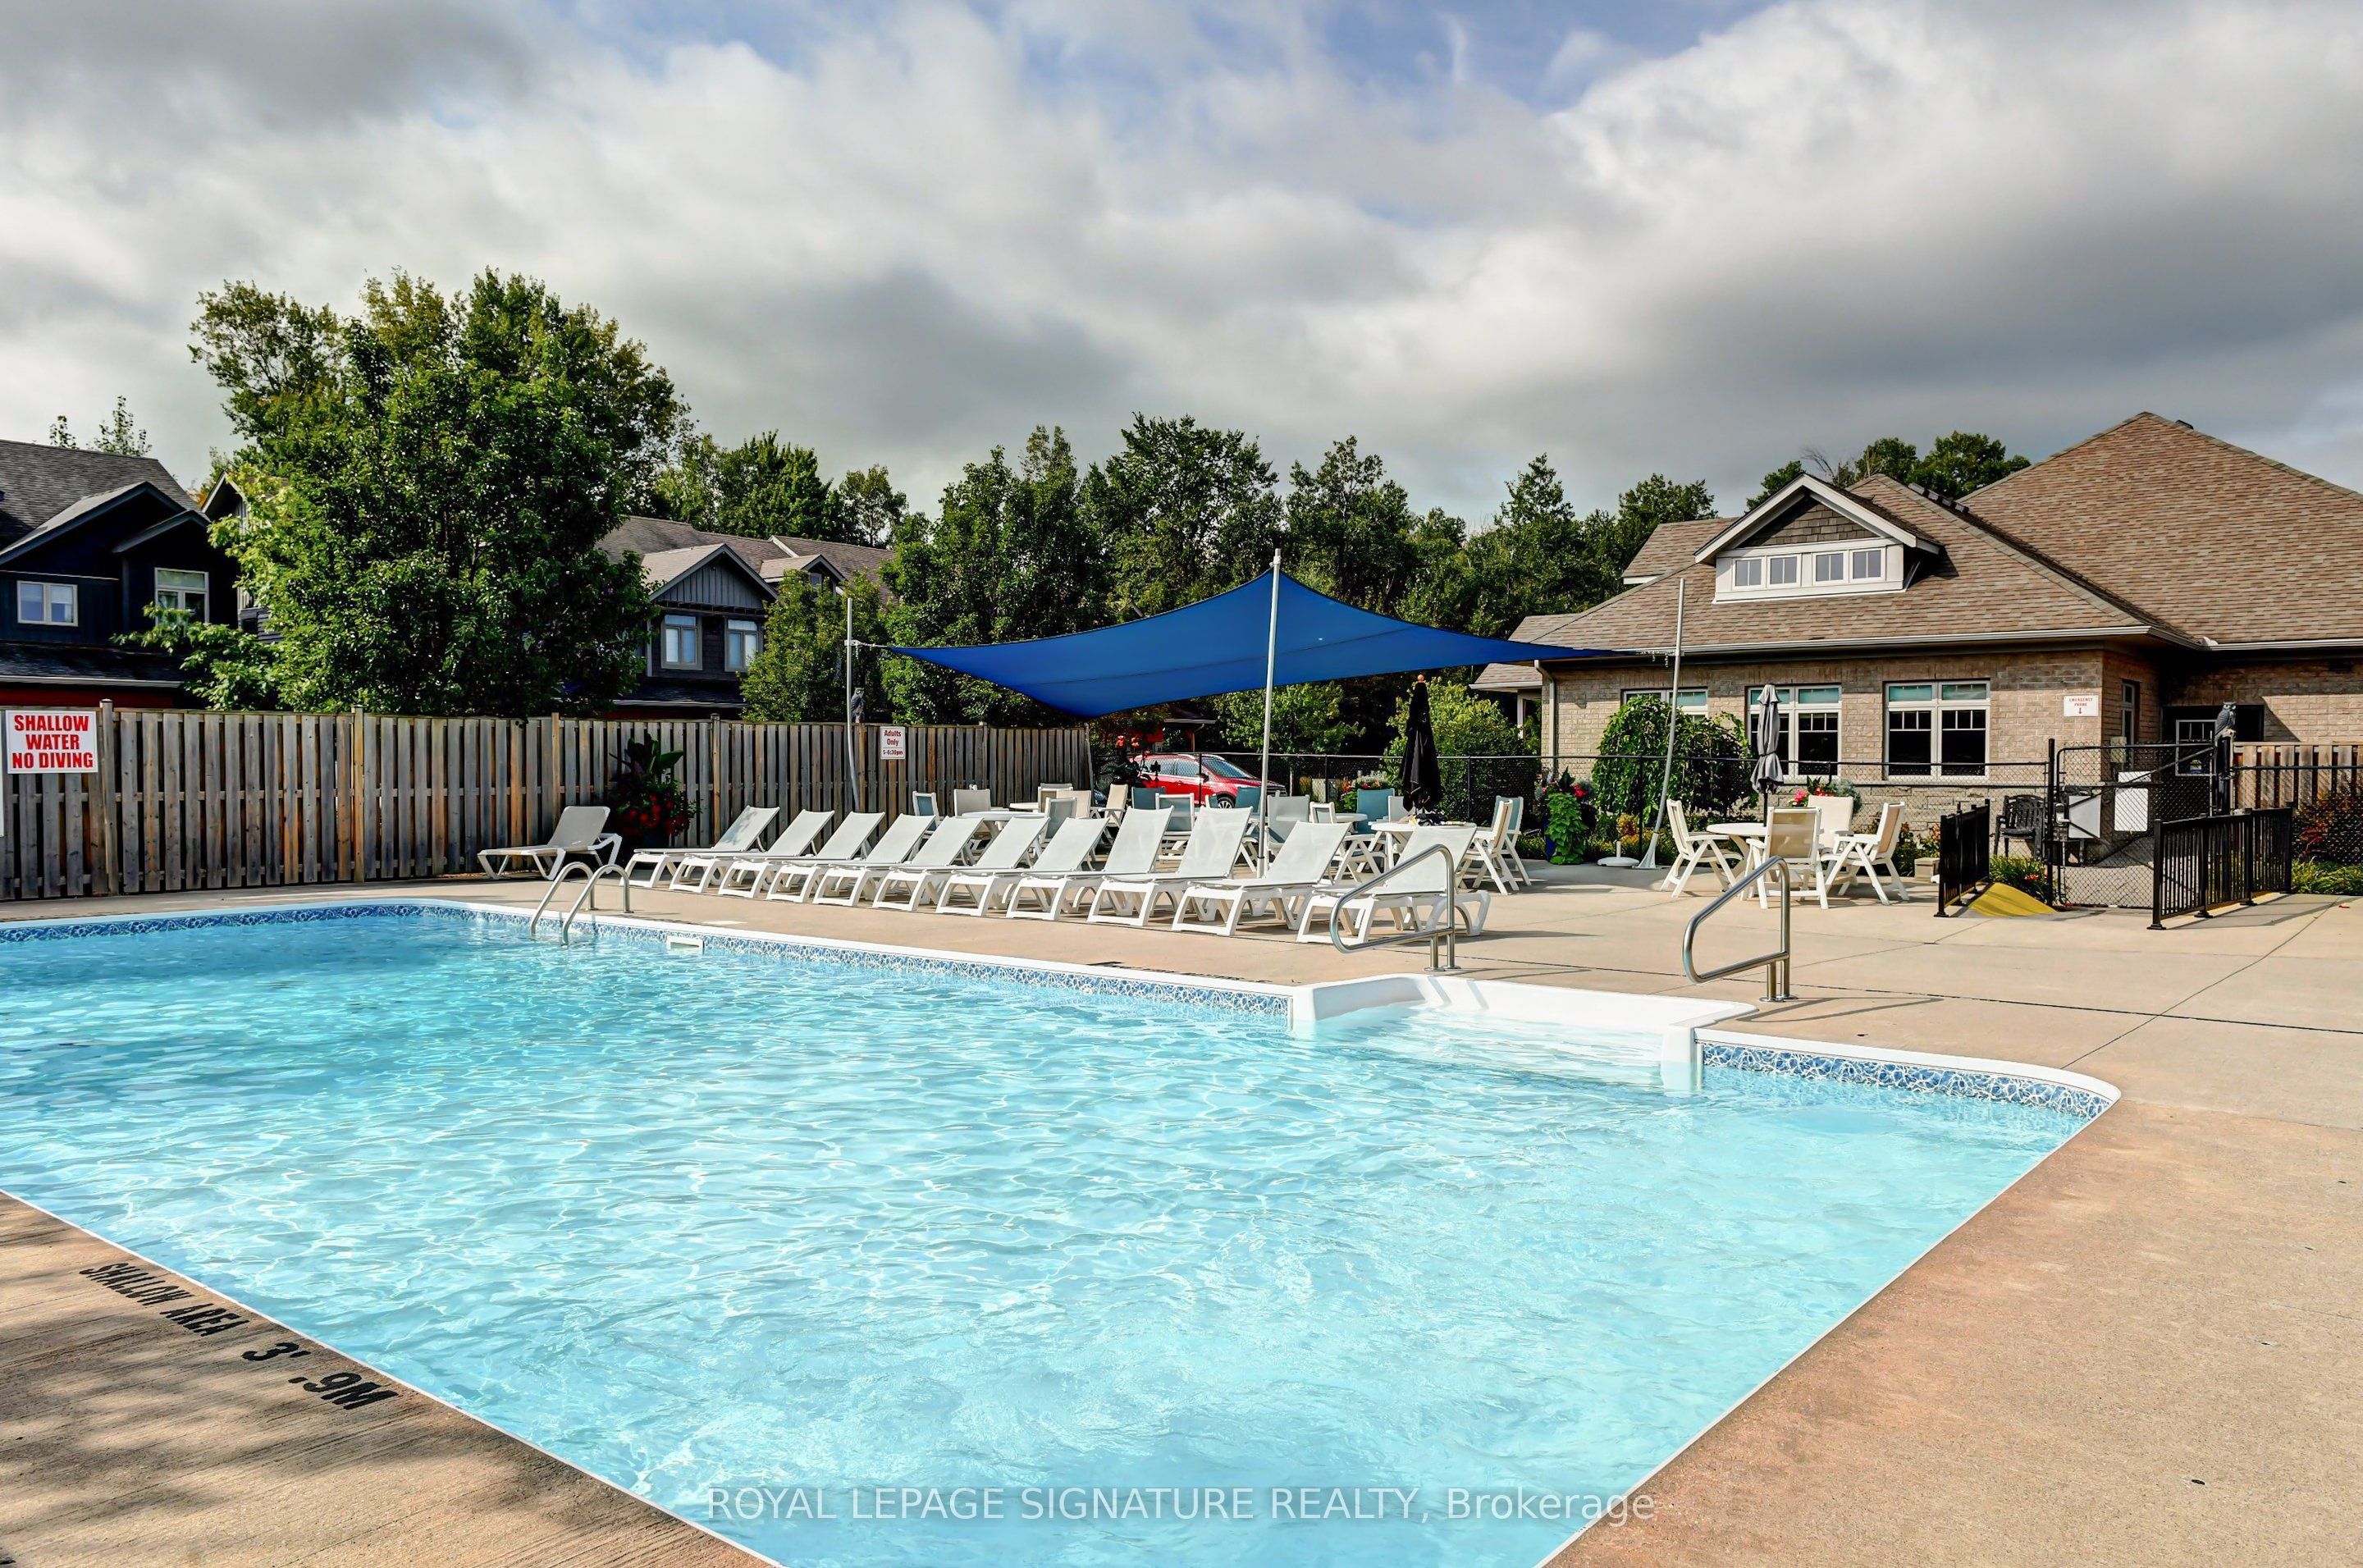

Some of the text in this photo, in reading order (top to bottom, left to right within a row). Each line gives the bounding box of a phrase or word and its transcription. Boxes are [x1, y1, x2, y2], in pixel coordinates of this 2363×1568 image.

[14, 715, 89, 731] SHALLOW
[25, 734, 80, 750] WATER
[12, 752, 93, 768] NO DIVING
[79, 1263, 249, 1337] SHALLOW AREA
